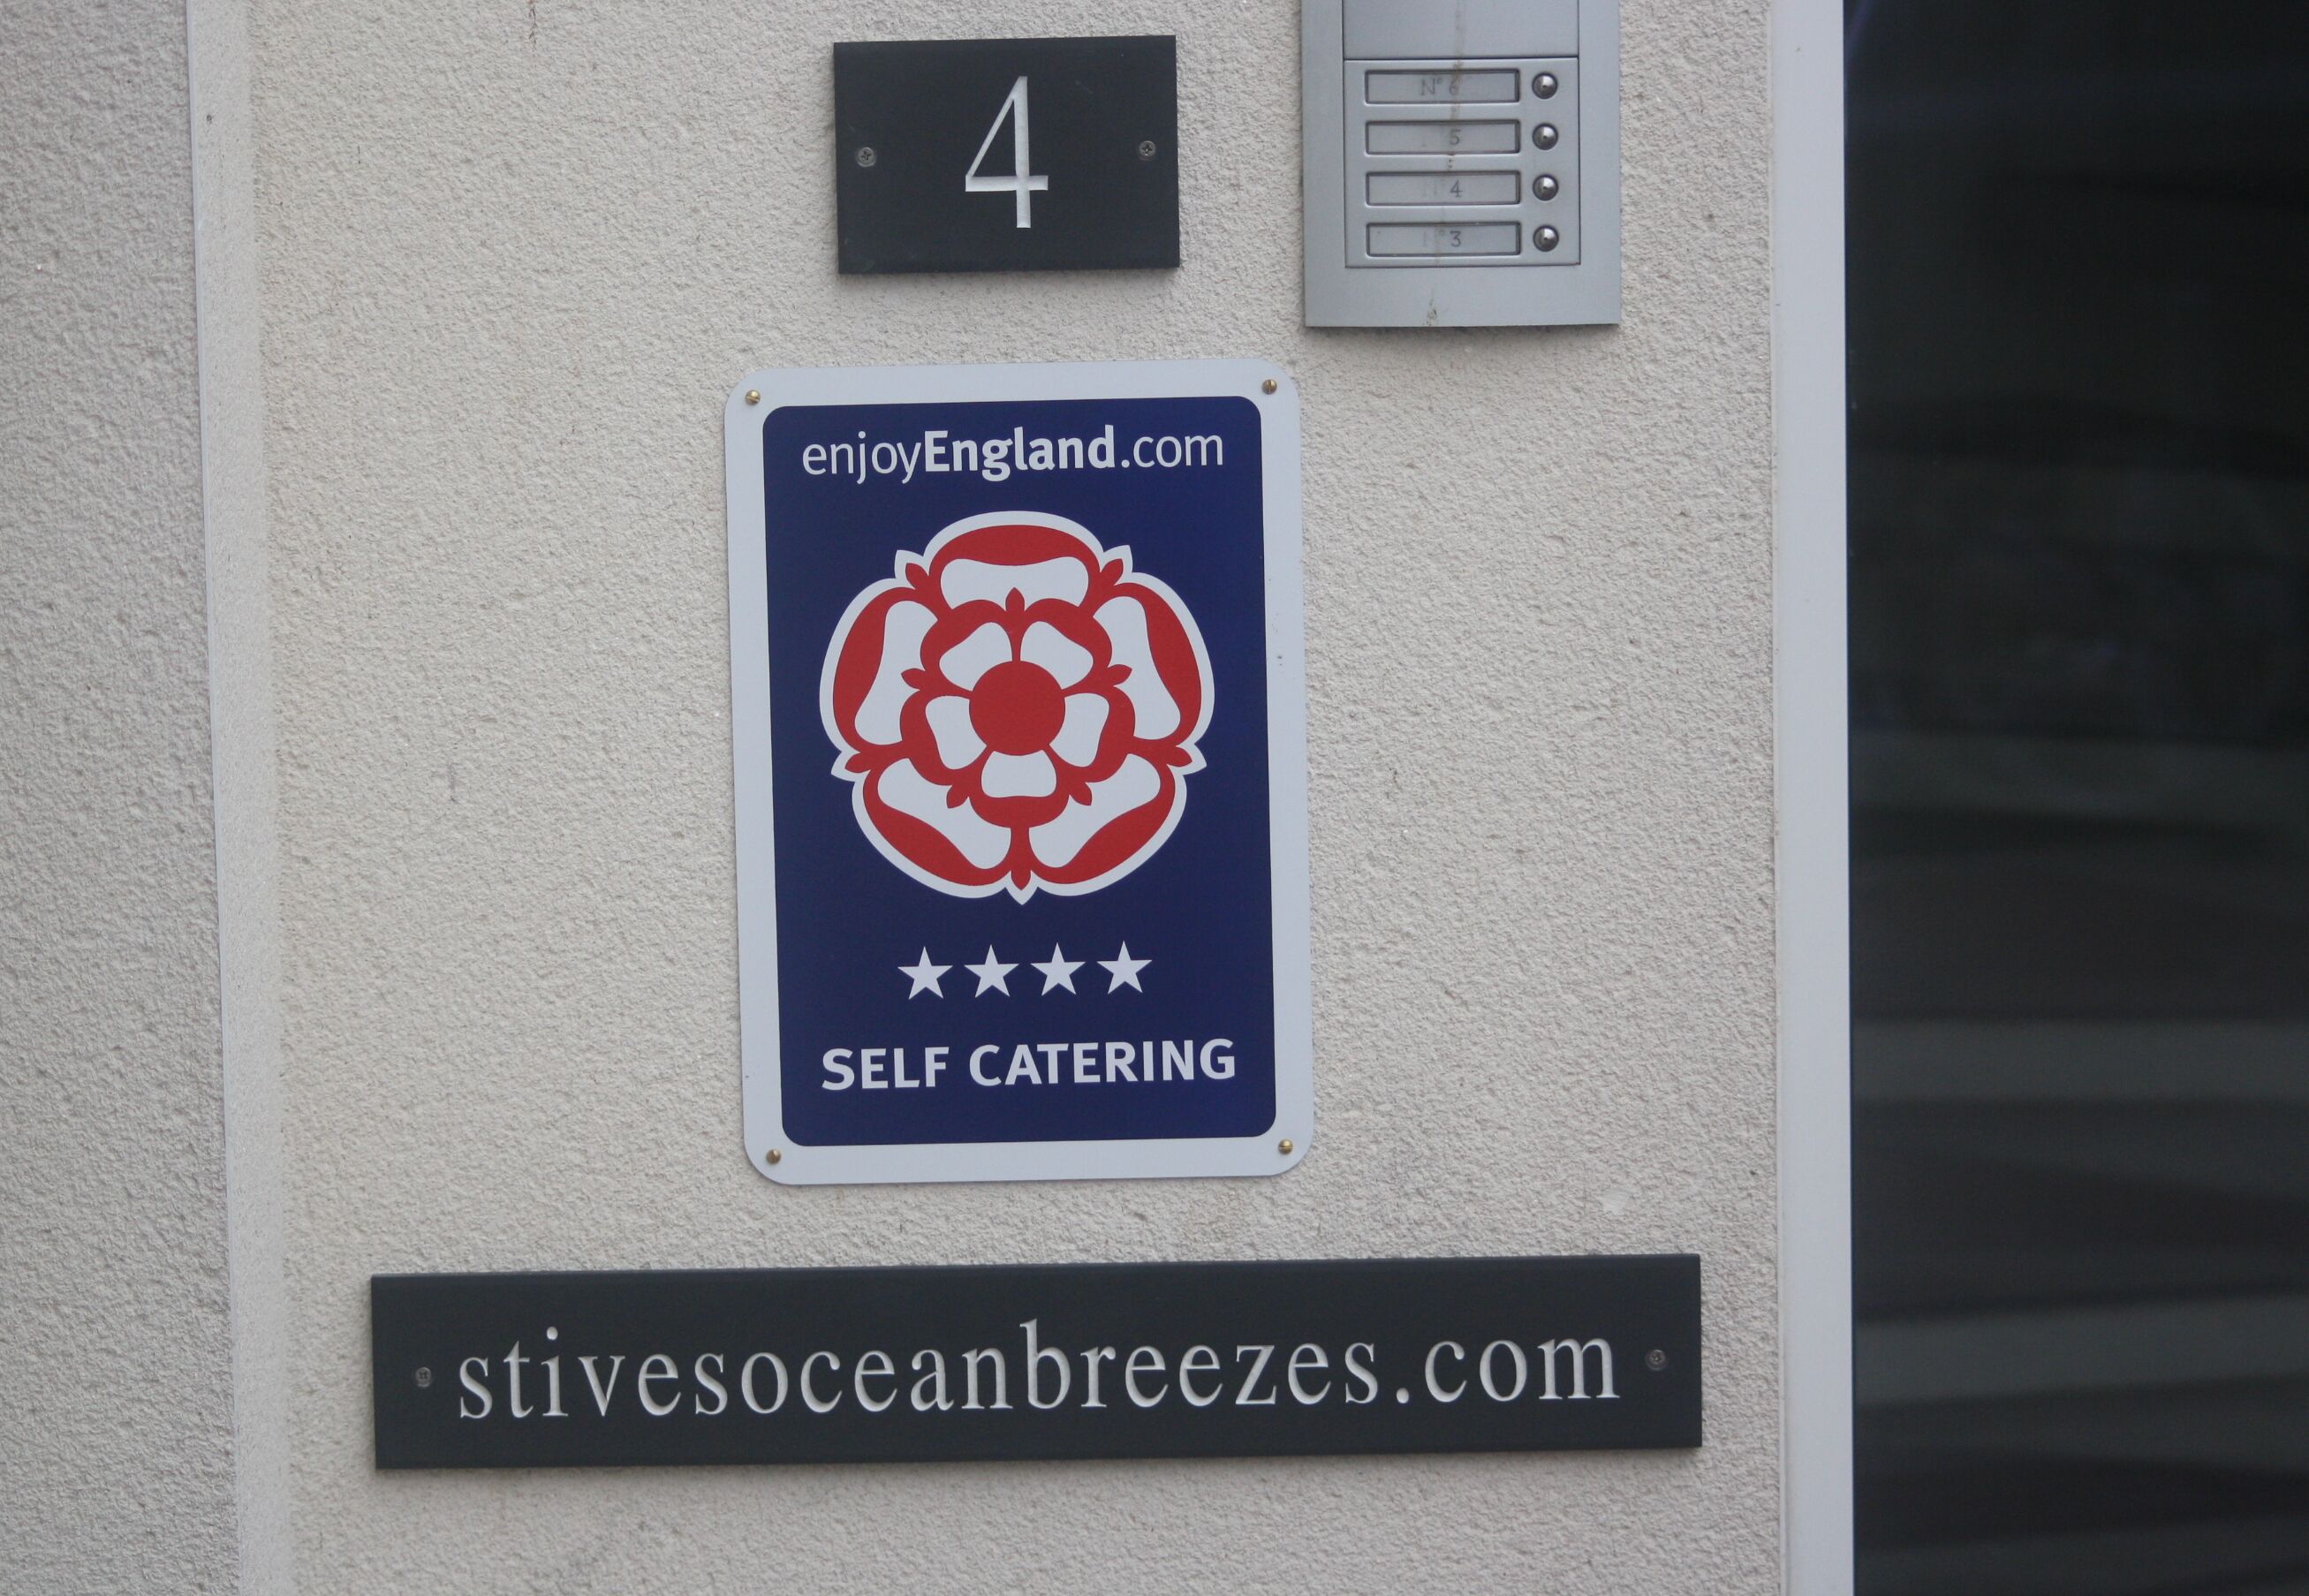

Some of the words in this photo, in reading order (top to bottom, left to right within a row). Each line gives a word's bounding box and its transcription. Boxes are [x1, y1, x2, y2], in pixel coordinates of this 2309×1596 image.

[965, 76, 1049, 228] 4
[1450, 129, 1460, 146] 5
[1450, 179, 1463, 198] 4
[1450, 231, 1461, 247] 3
[802, 424, 1223, 485] enjoyEngland.com
[821, 1046, 950, 1091] SELF
[969, 1038, 1236, 1086] CATERING
[458, 1319, 1621, 1419] stivesoceanbreezes.com
